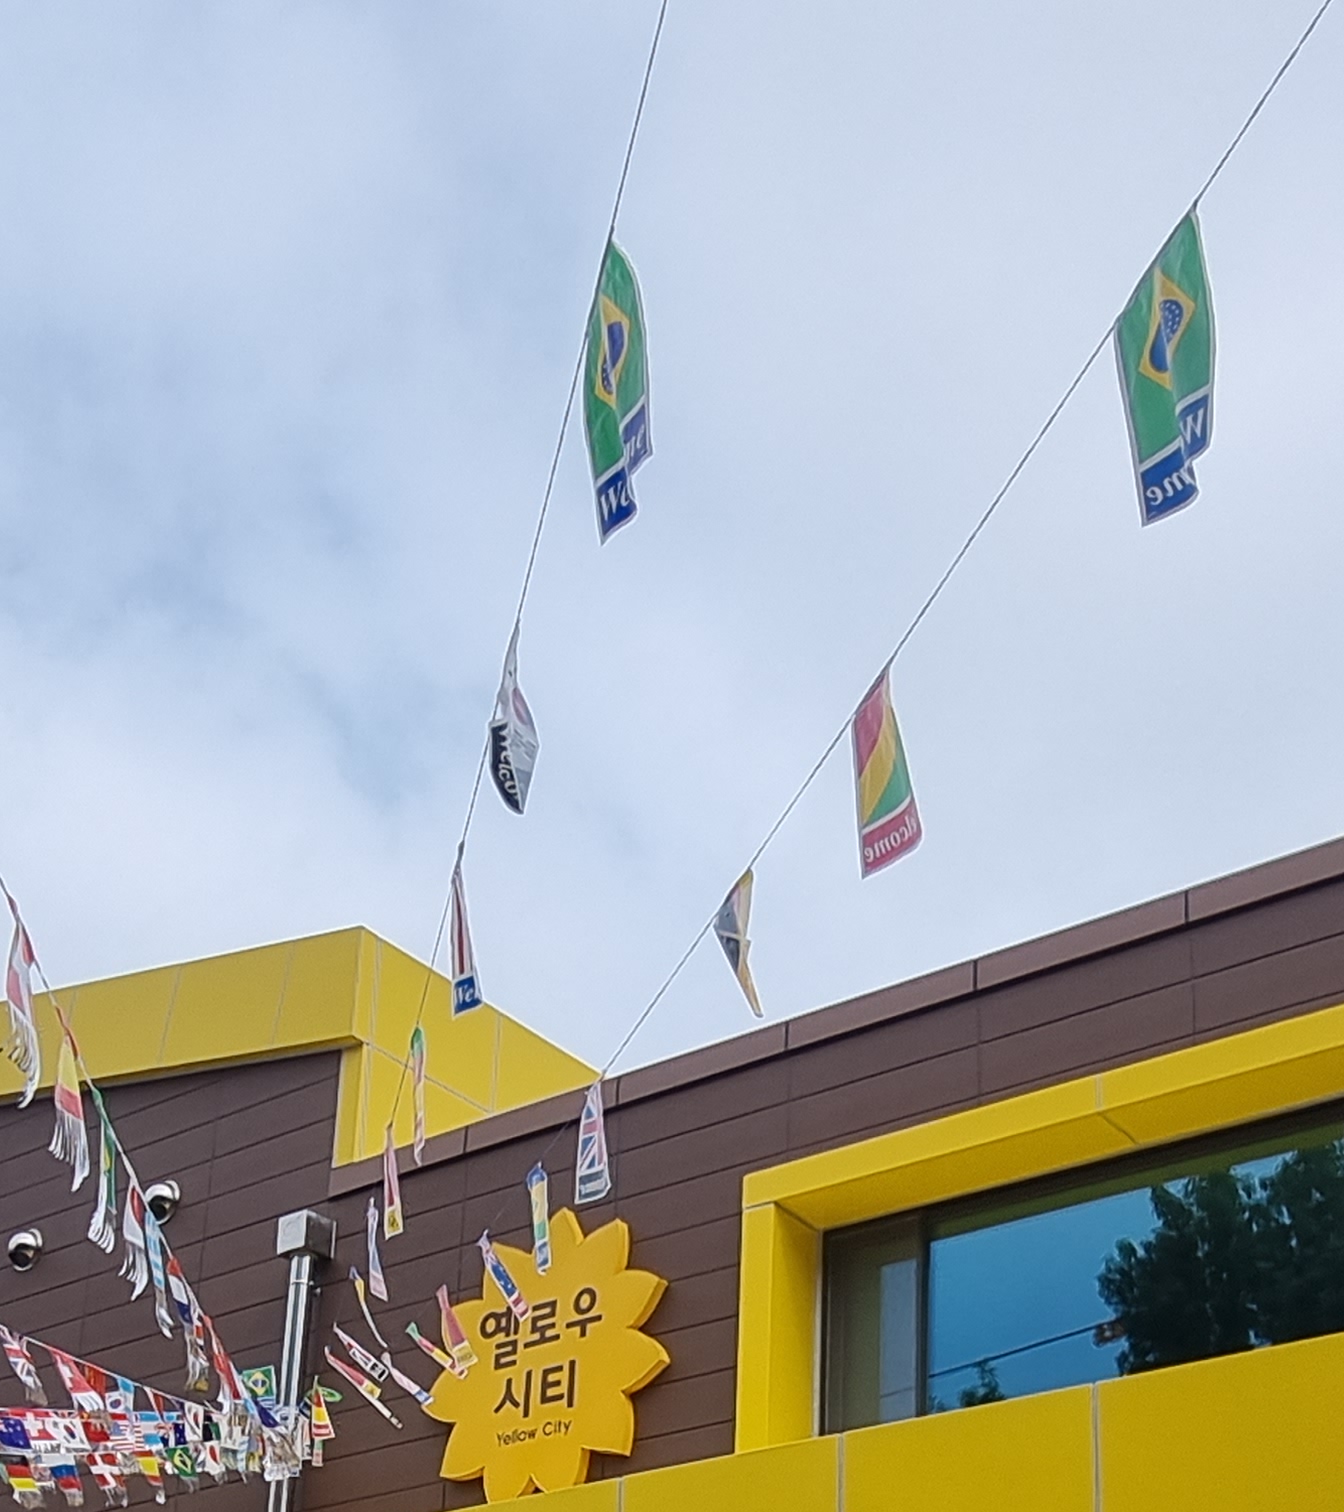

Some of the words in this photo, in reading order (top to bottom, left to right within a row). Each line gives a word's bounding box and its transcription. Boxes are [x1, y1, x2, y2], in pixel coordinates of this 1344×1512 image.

[478, 1286, 603, 1371] 옐로우
[492, 1358, 577, 1419] 시티
[496, 1429, 538, 1447] Yellow
[542, 1419, 572, 1437] City
